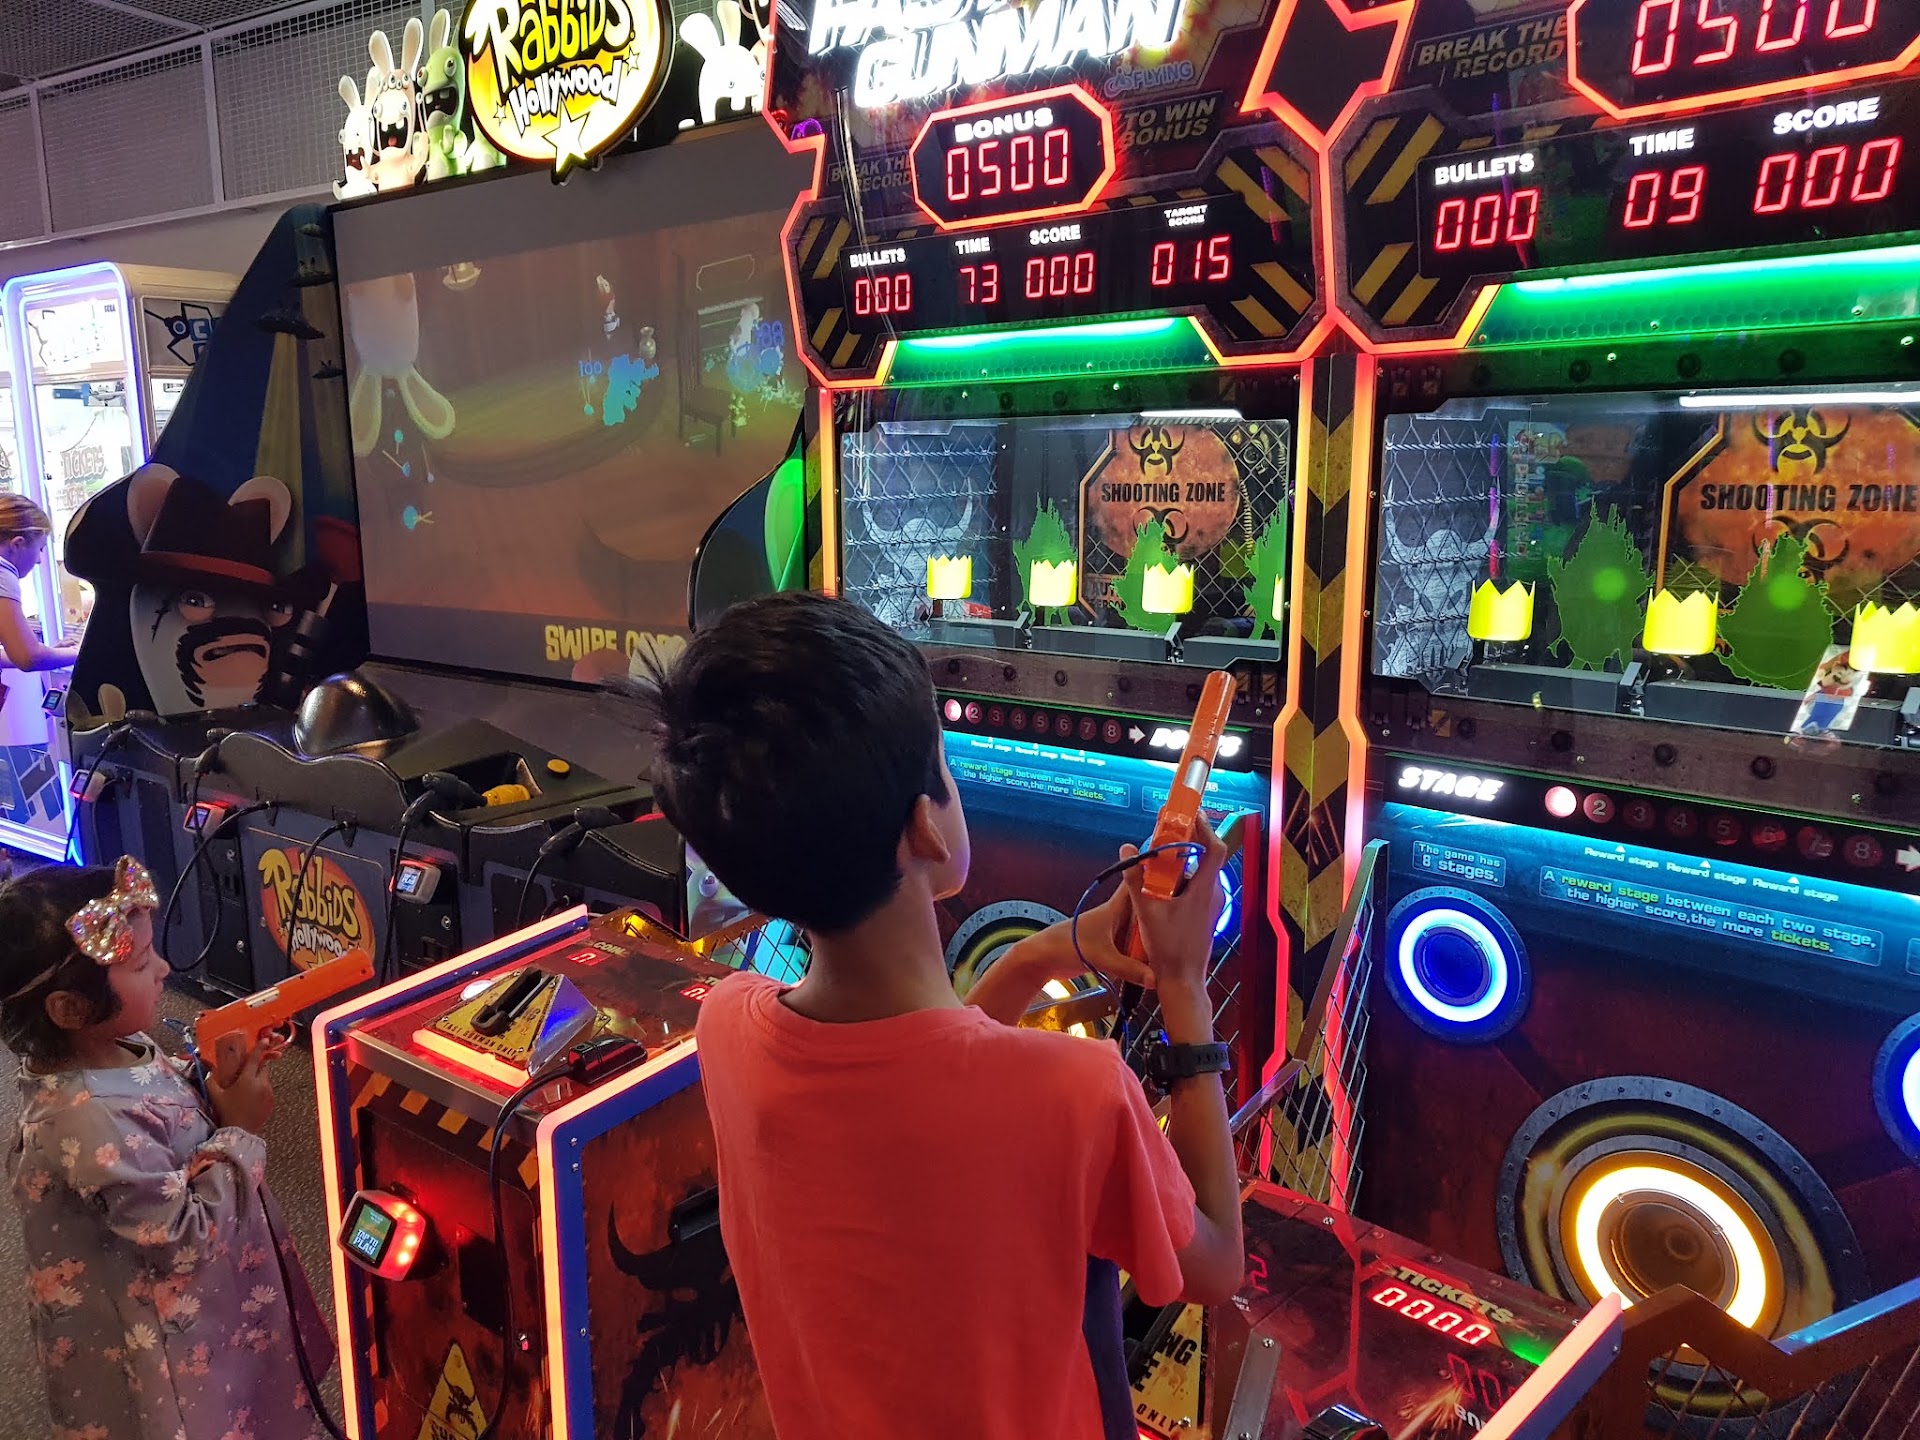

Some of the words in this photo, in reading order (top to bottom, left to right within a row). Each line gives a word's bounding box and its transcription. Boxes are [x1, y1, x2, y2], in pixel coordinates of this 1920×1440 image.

[1418, 26, 1510, 67] BREAK
[1517, 15, 1567, 45] THE
[1132, 60, 1194, 89] FLYING
[1453, 40, 1566, 79] RECORD
[509, 58, 624, 138] Hollywood
[1124, 109, 1157, 132] TO
[1165, 97, 1217, 123] WIN
[955, 107, 1054, 142] BONUS
[1772, 97, 1881, 135] SCORE
[1119, 118, 1209, 150] BONUS
[1629, 127, 1695, 156] TIME
[946, 128, 1069, 201] 0500
[1434, 153, 1535, 185] BULLETS
[1753, 136, 1902, 214] 000
[1164, 204, 1208, 218] TARGET
[1623, 165, 1705, 228] 09
[1029, 224, 1082, 246] SCORE
[1168, 214, 1205, 227] SCORE
[1435, 189, 1539, 250] 000
[849, 248, 906, 268] BULLETS
[955, 237, 991, 254] TIME
[1151, 235, 1231, 286] 015
[959, 263, 998, 304] 73
[1025, 252, 1095, 299] 000
[855, 273, 911, 315] 000
[1101, 482, 1180, 503] SHOOTING
[1186, 482, 1226, 503] ZONE
[1701, 484, 1836, 512] SHOOTING
[1849, 484, 1919, 512] ZONE
[545, 625, 617, 661] SWIPE
[970, 707, 979, 719] 2
[992, 710, 1000, 722] 3
[1014, 713, 1023, 725] 4
[1036, 715, 1045, 728] 5
[1060, 718, 1069, 731] 6
[1083, 721, 1092, 734] 7
[1107, 724, 1117, 738] 8
[949, 759, 957, 768] A
[960, 762, 988, 773] reward
[991, 766, 1013, 777] stage
[1016, 769, 1051, 782] between
[1054, 776, 1074, 786] each
[1077, 779, 1096, 790] two
[964, 770, 976, 779] the
[979, 772, 1003, 783] higher
[1047, 784, 1070, 794] more
[1398, 766, 1505, 802] STAGE
[1593, 799, 1607, 816] 2
[1634, 805, 1646, 822] 3
[1674, 813, 1688, 829] 4
[1855, 840, 1871, 859] 8
[1419, 843, 1440, 857] The
[1444, 850, 1474, 869] game
[1479, 854, 1500, 868] has
[1421, 854, 1432, 868] 8
[1438, 858, 1499, 883] stages.
[1544, 870, 1555, 882] A
[1561, 874, 1612, 893] reward
[1618, 885, 1659, 904] stage
[1666, 894, 1731, 919] between
[1737, 909, 1774, 926] each
[1782, 917, 1815, 934] two
[1822, 926, 1876, 949] stage,
[1567, 888, 1590, 901] the
[1595, 892, 1639, 911] higher
[1723, 920, 1763, 938] more
[1771, 928, 1835, 953] tickets.
[286, 921, 350, 958] Hollywoo
[1398, 1266, 1515, 1324] TICKETS
[1372, 1287, 1492, 1345] 0000
[1136, 1402, 1179, 1432] ONLY
